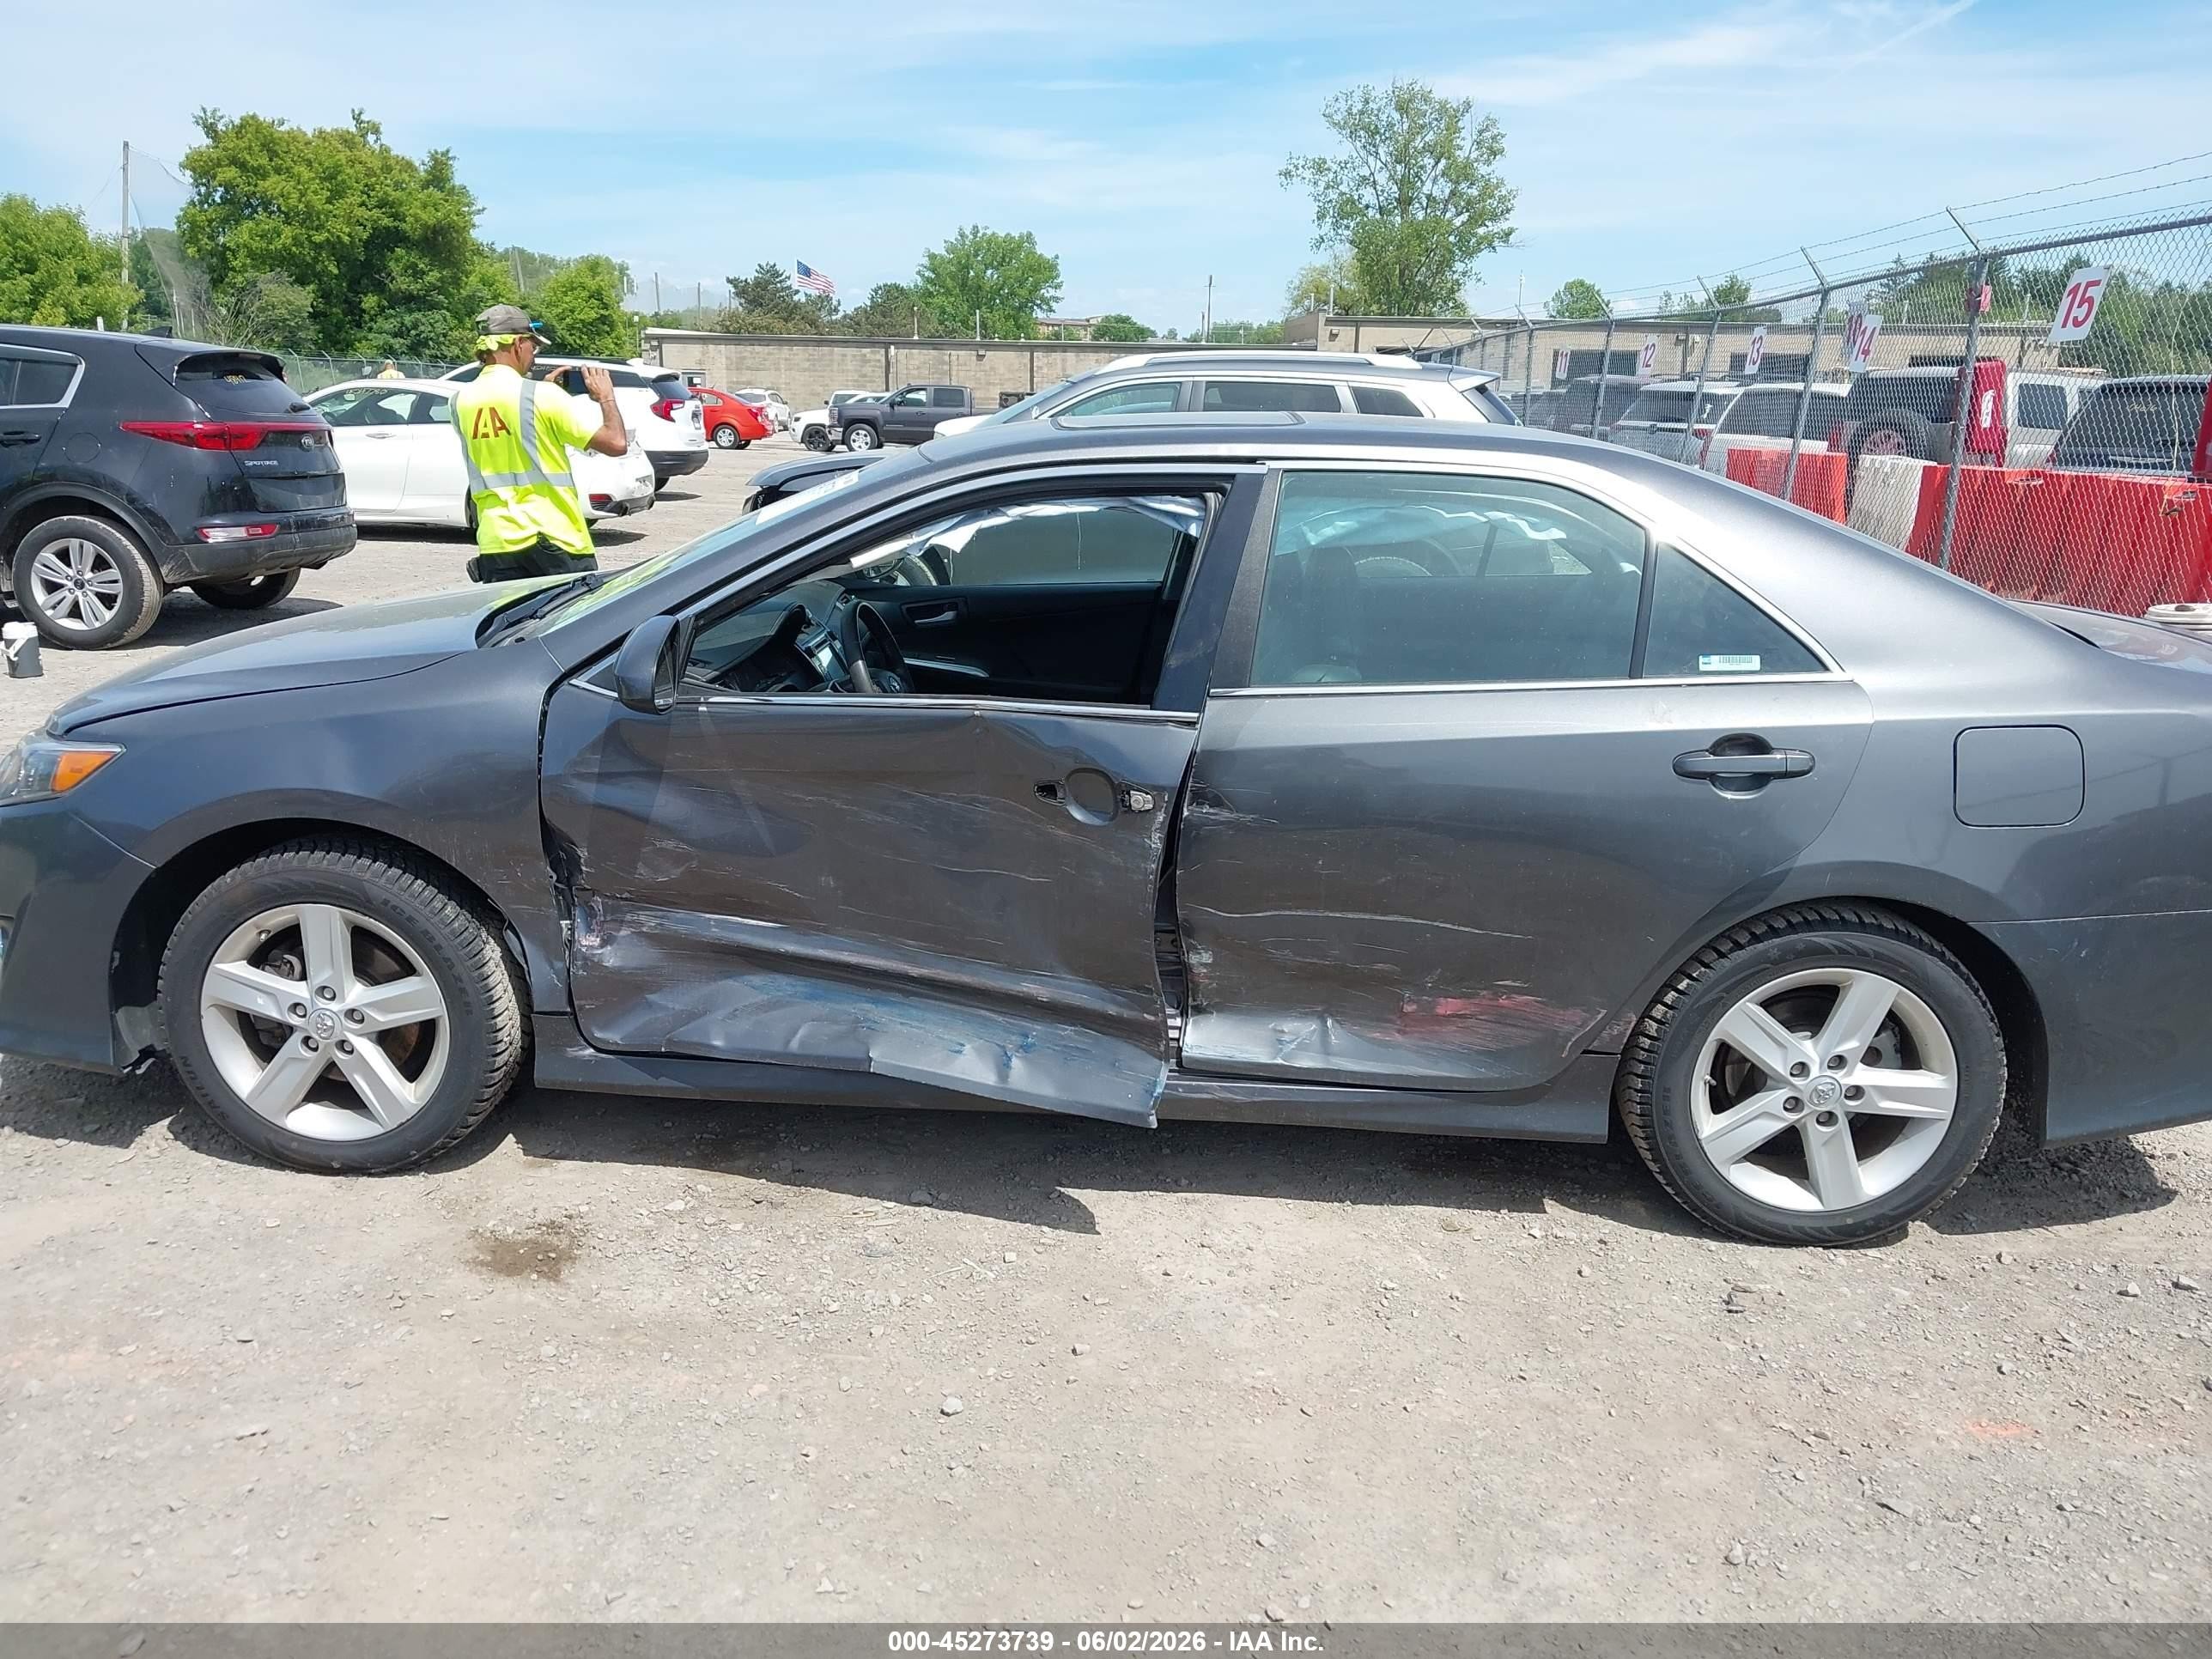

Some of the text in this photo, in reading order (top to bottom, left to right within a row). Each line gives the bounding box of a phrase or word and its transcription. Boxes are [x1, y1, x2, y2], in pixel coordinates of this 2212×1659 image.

[2061, 279, 2102, 329] 15
[1642, 343, 1656, 368] 12
[1748, 334, 1764, 367] 13
[1855, 326, 1877, 363] 14
[1558, 350, 1570, 373] 11
